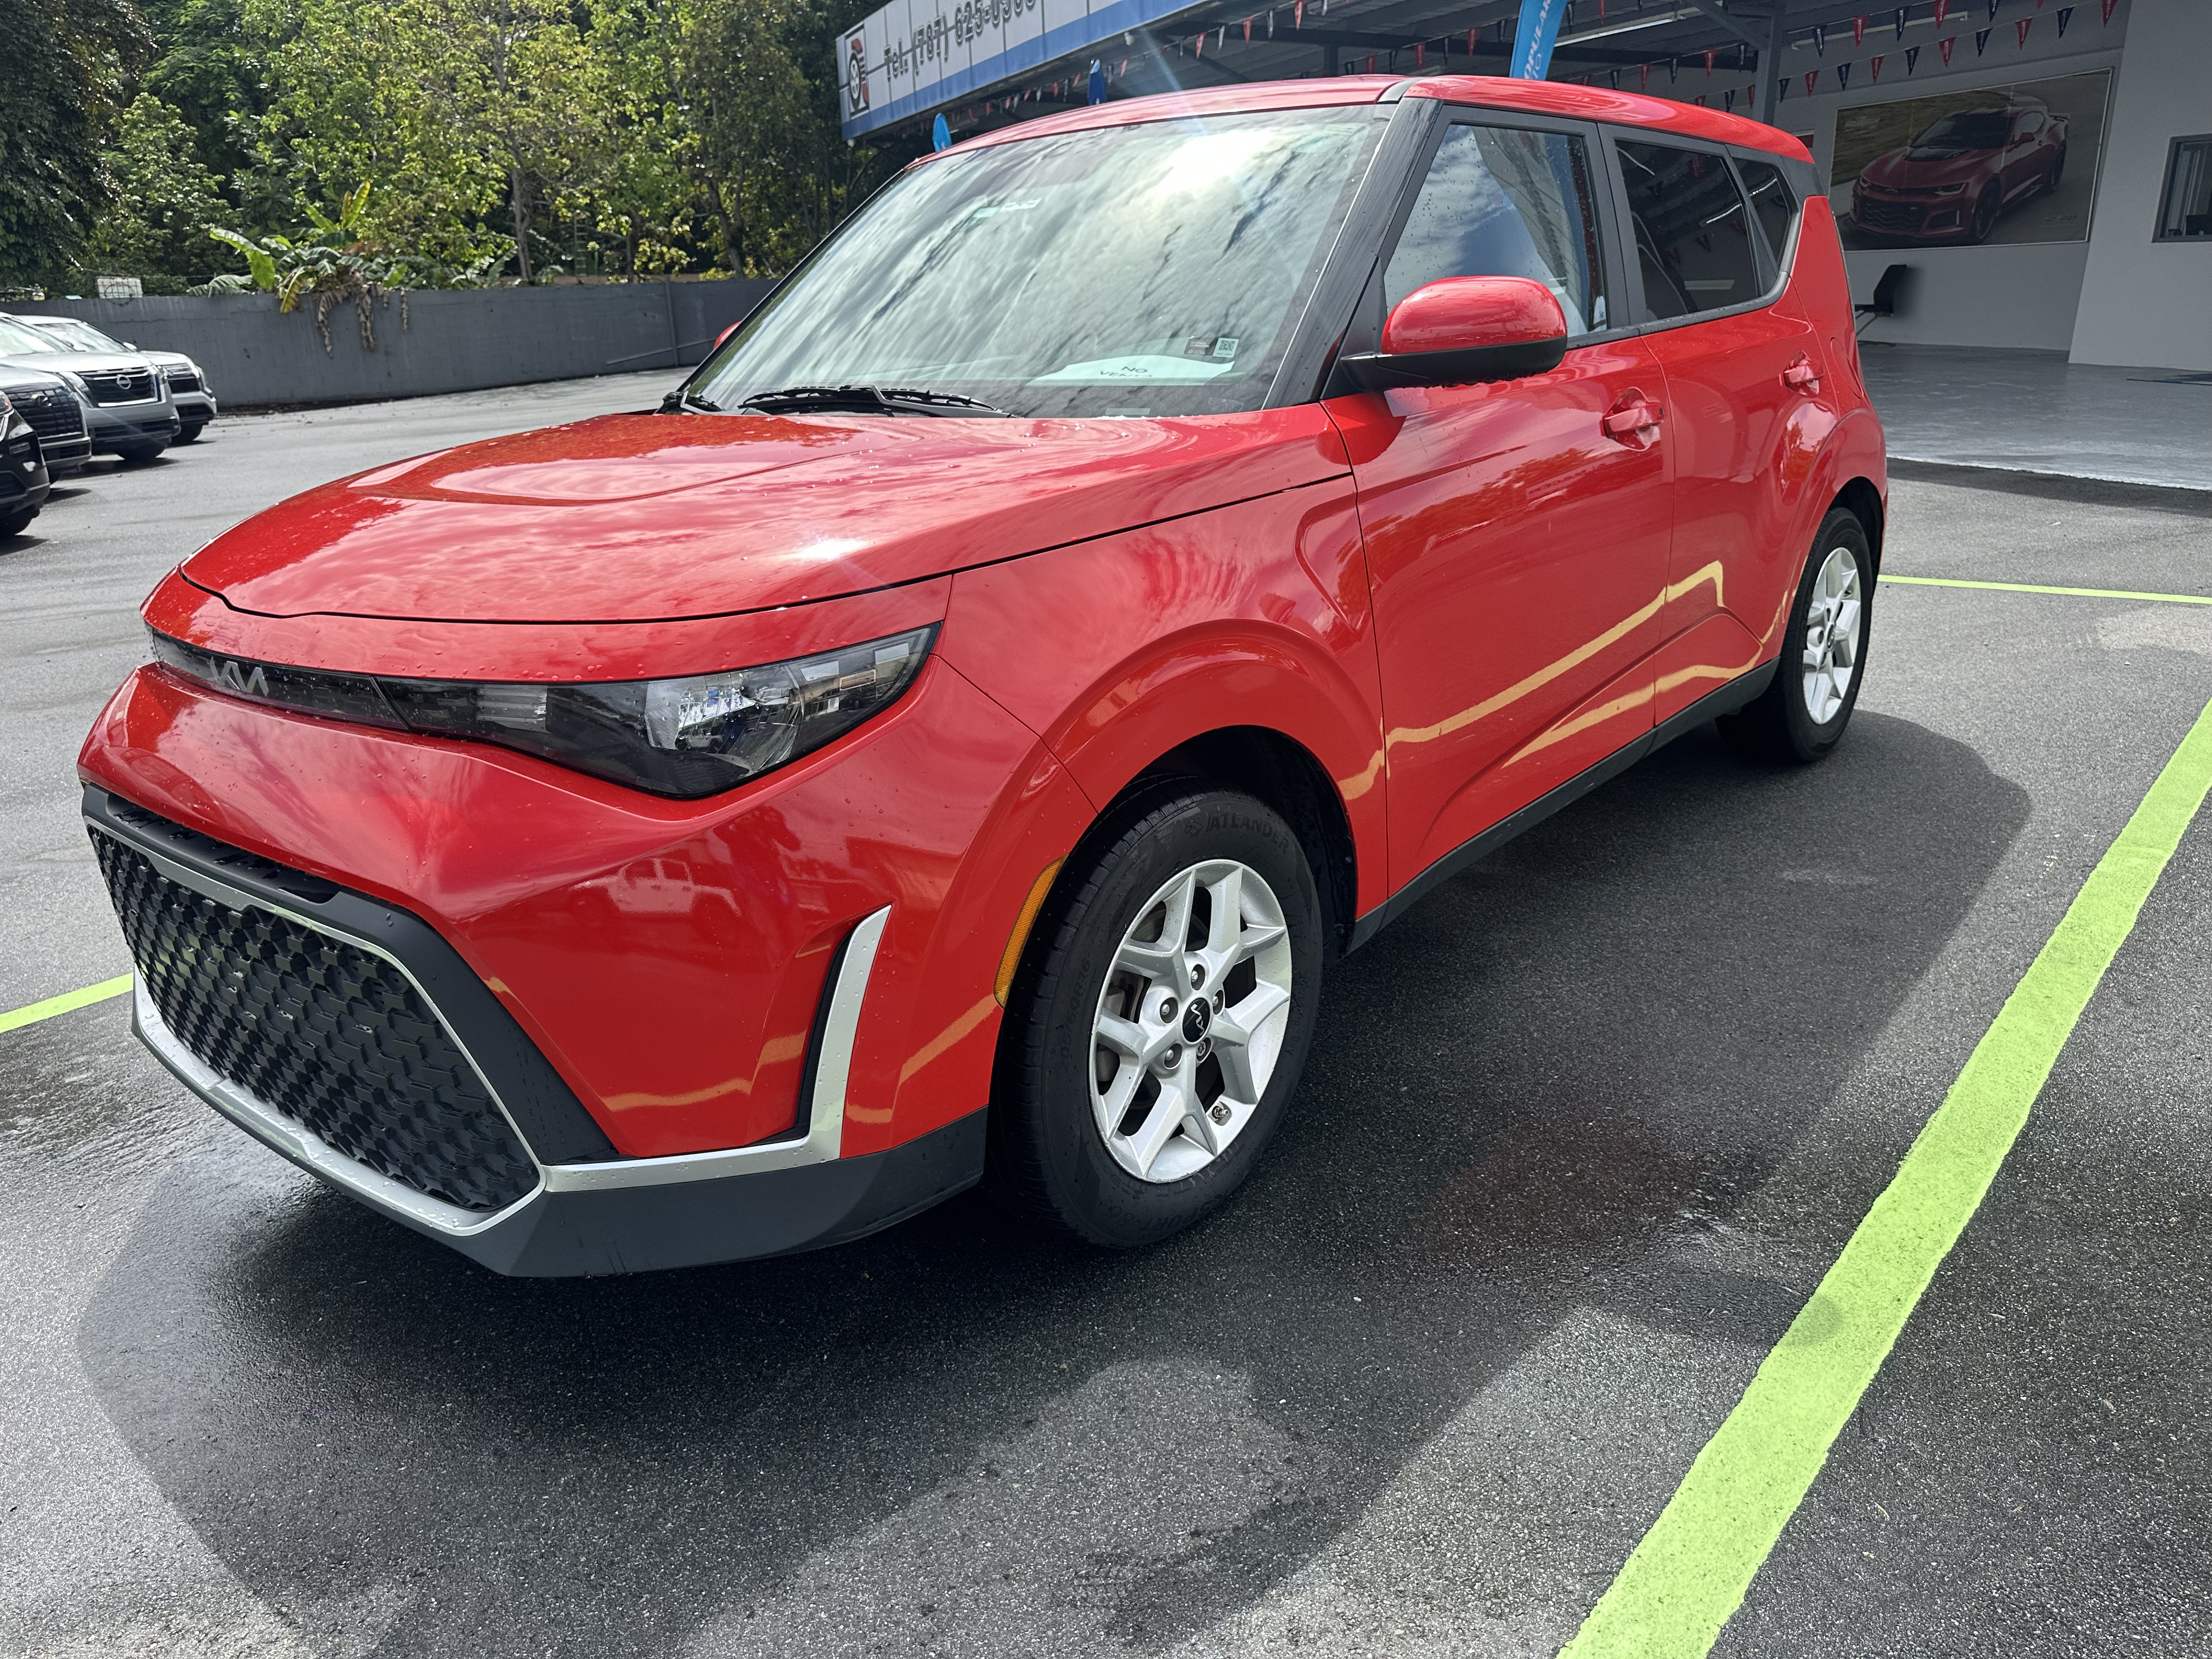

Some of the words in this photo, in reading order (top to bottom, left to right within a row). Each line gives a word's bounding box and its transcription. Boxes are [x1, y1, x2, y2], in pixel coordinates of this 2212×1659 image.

[884, 41, 908, 80] Tel.
[912, 14, 949, 75] (787)
[1208, 812, 1289, 854] ATLANDER
